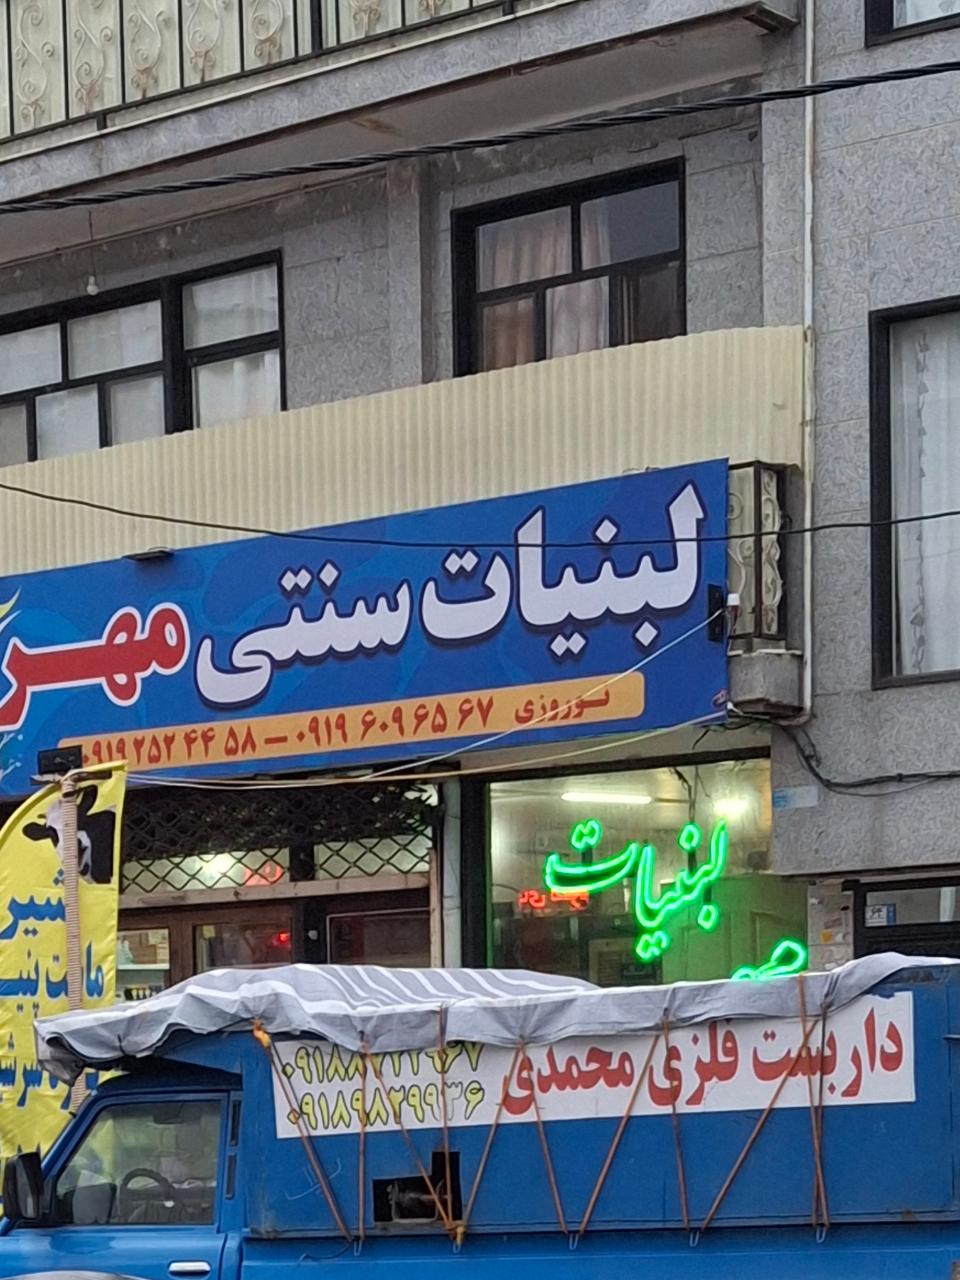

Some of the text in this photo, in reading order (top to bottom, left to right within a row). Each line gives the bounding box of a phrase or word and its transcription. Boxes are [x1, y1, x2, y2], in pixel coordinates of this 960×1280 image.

[418, 480, 705, 658] لبنیات
[194, 560, 413, 704] سنتی
[514, 689, 610, 726] نوروزی
[544, 817, 730, 962] لبنیات
[503, 1045, 635, 1116] محمدی
[647, 1018, 740, 1107] فلزی
